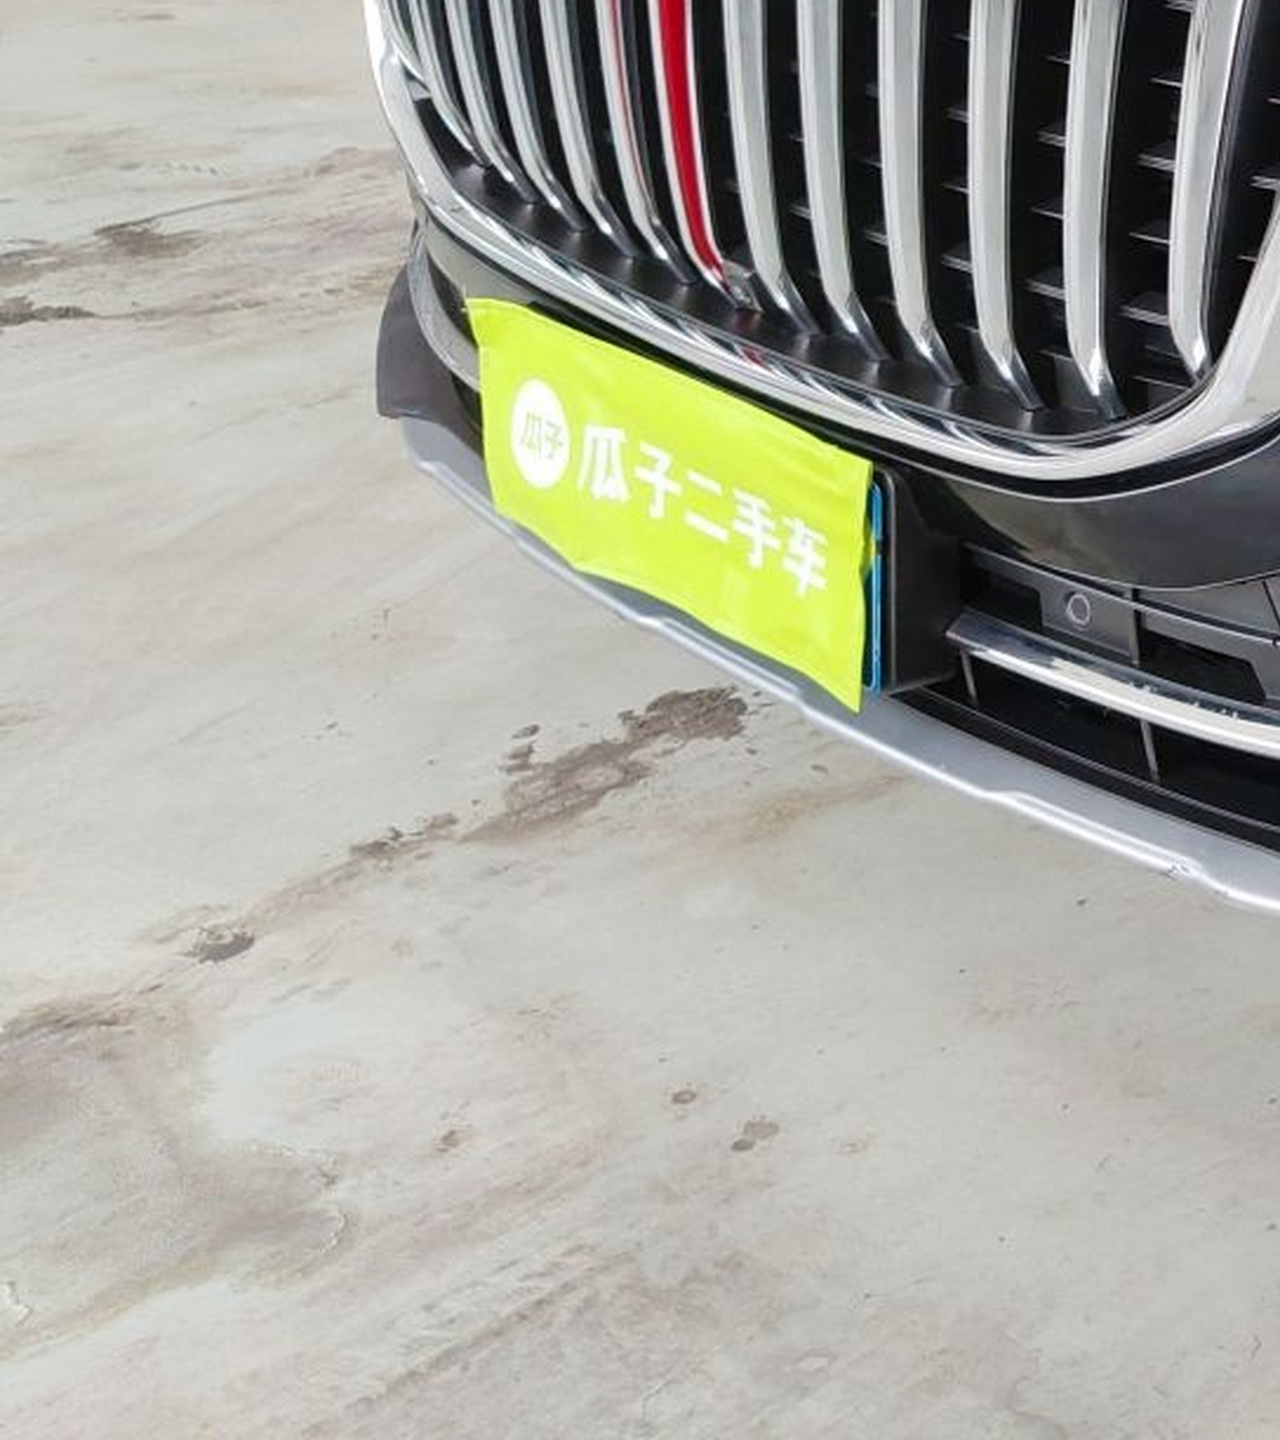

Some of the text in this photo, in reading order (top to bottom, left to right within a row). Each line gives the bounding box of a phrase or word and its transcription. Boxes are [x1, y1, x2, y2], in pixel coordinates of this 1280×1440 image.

[522, 412, 826, 595] 瓜子 瓜子二手车
